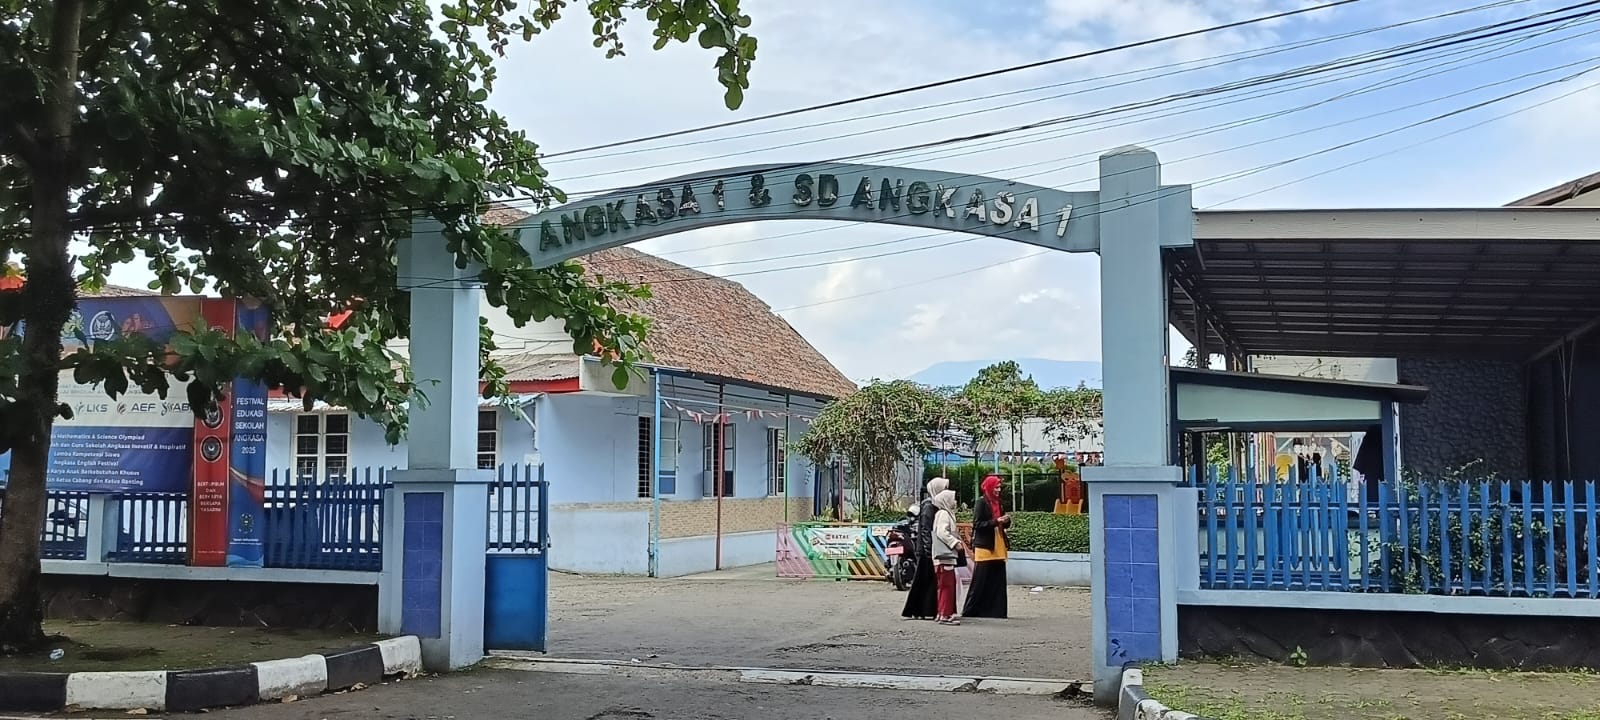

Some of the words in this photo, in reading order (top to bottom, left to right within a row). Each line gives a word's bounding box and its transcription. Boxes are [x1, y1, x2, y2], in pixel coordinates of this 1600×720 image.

[539, 184, 701, 251] ANGKASA
[712, 180, 725, 210] 1
[750, 174, 772, 207] &
[792, 173, 839, 207] SD
[849, 176, 1039, 232] ANGKASA
[1056, 204, 1073, 237] 1
[236, 397, 265, 405] FESTIVAL
[86, 403, 108, 413] LKS
[131, 403, 156, 412] AEF
[236, 409, 264, 418] EDUKASI
[234, 421, 265, 430] SEKOLAH
[233, 433, 265, 442] ANGKASA
[241, 446, 256, 454] 2025
